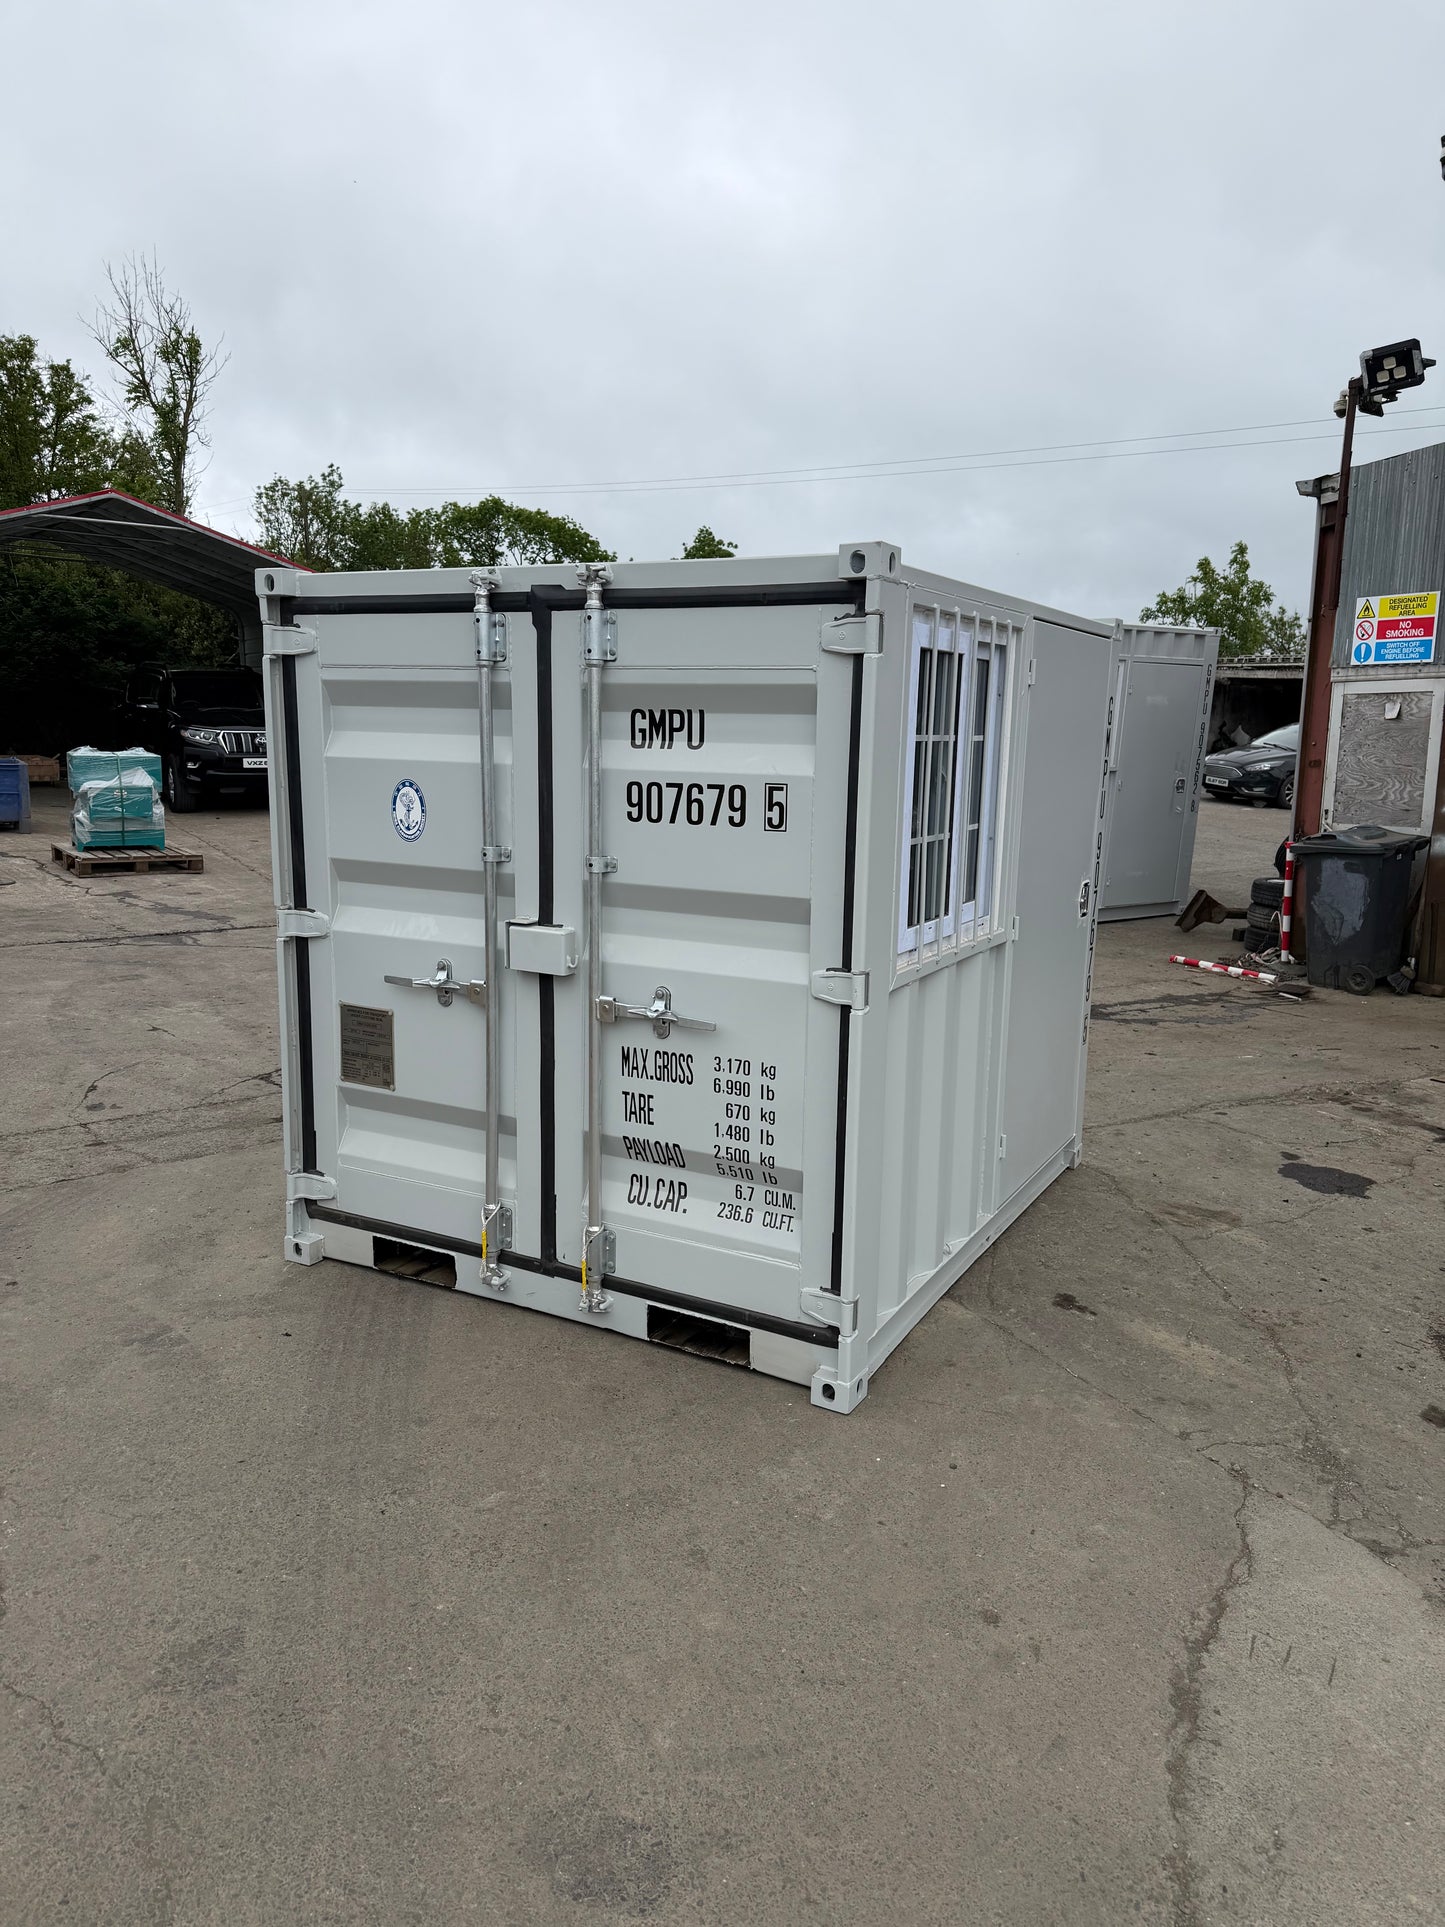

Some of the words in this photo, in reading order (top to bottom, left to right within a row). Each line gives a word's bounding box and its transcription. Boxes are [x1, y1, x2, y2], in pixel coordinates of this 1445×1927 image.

[1389, 596, 1428, 604] DESIGNATED
[1386, 628, 1424, 638] SMOKING
[630, 708, 705, 750] GMPU
[626, 781, 746, 827] 907679
[767, 786, 785, 829] 5
[621, 1046, 694, 1085] MAX.GROSS
[761, 1062, 776, 1080] kg
[760, 1084, 775, 1100] lb
[622, 1091, 654, 1125] TARE
[726, 1103, 750, 1121] 670
[760, 1108, 776, 1125] kg
[623, 1136, 686, 1168] PAYLOAD
[760, 1152, 775, 1169] kg
[760, 1128, 774, 1146] lb
[762, 1171, 778, 1185] lb
[627, 1174, 688, 1214] CU.CAP.
[735, 1185, 754, 1201] 6.7
[765, 1190, 796, 1211] CU.M.
[717, 1202, 753, 1223] 236.6
[762, 1211, 794, 1232] CU.FT.
